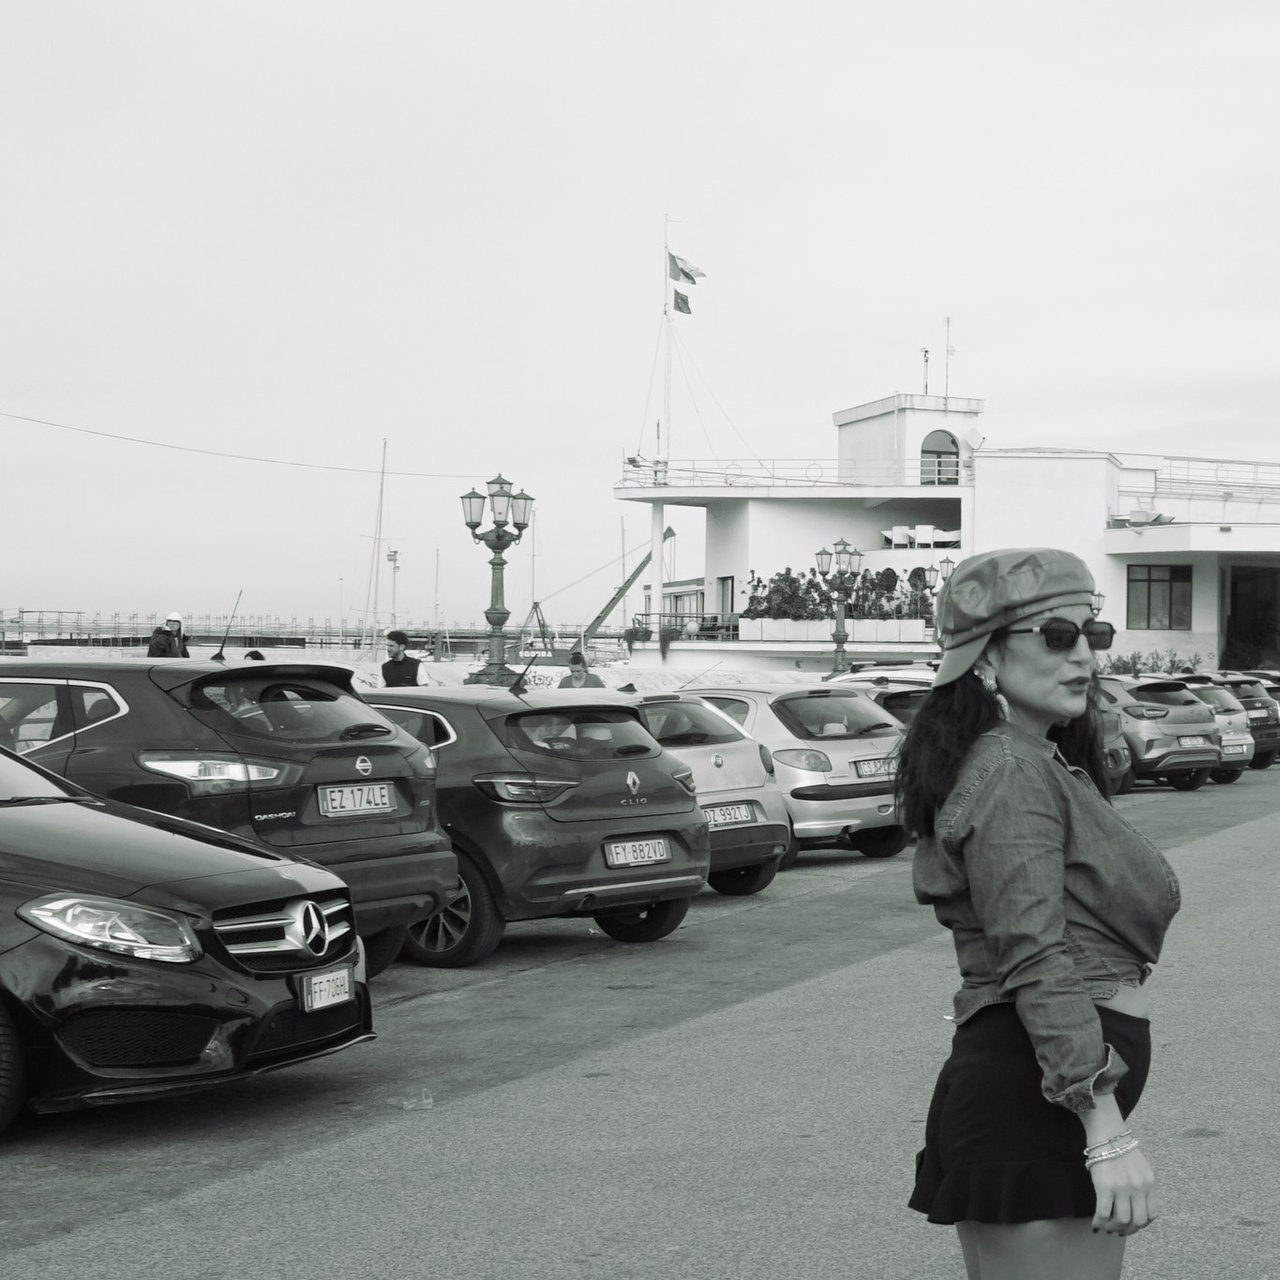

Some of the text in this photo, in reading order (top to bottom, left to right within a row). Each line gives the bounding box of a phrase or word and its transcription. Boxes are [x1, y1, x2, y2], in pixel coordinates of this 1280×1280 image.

[330, 787, 387, 809] EZ 174LE
[620, 797, 648, 806] CLIO
[613, 841, 665, 862] FY 882VD
